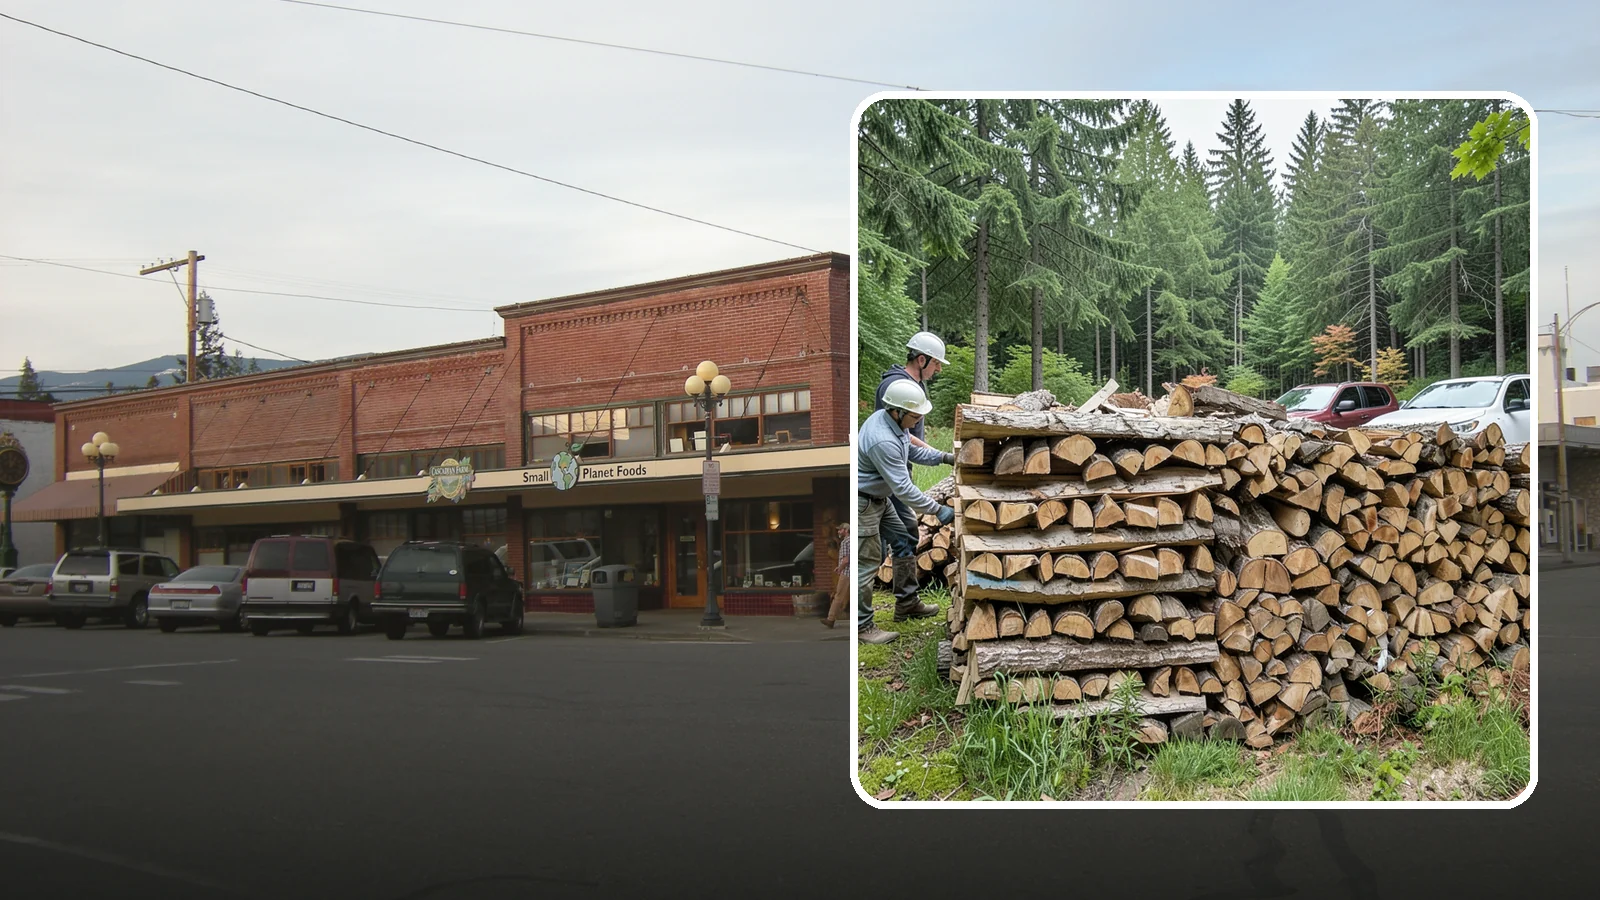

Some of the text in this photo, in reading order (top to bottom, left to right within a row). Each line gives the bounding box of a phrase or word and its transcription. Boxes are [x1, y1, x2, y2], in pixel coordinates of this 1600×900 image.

[523, 464, 647, 483] Small Planet Foods
